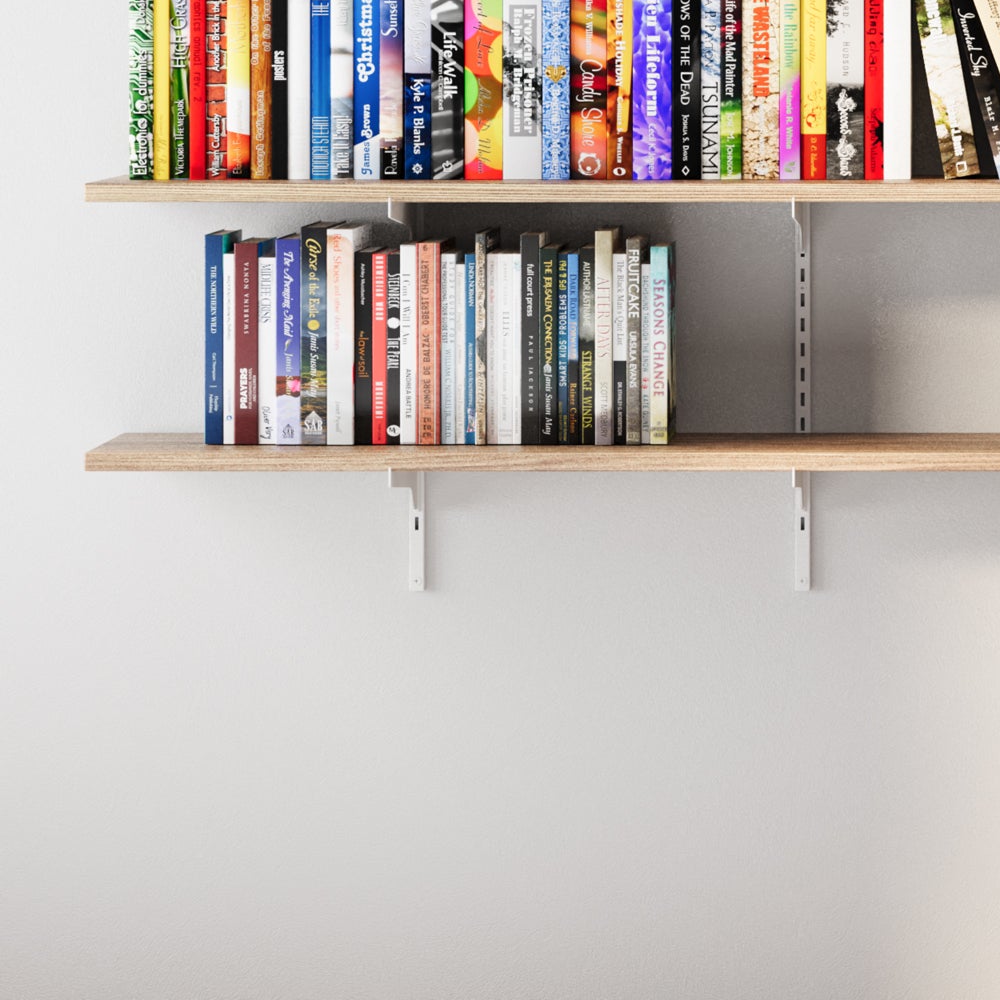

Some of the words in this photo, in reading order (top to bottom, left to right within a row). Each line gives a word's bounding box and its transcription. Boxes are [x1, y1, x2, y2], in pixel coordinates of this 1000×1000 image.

[312, 2, 329, 17] THE
[381, 0, 398, 38] Sunset
[704, 11, 716, 21] P.
[725, 13, 736, 25] of
[783, 3, 797, 21] the
[443, 32, 457, 58] Life
[523, 7, 536, 61] Frozen
[680, 25, 691, 41] OF
[704, 25, 716, 68] PAYTON
[725, 25, 736, 39] the
[783, 24, 797, 69] Rainbow
[957, 8, 979, 51] Inverted
[969, 53, 988, 77] Sky
[171, 35, 187, 68] HIGH
[193, 37, 201, 66] annual
[272, 50, 286, 80] posters
[615, 40, 625, 87] HOLIDAY
[680, 45, 691, 65] THE
[725, 41, 736, 62] Mad
[753, 7, 769, 97] WASTELAND
[133, 49, 148, 96] dummies
[193, 72, 201, 90] rev.
[443, 61, 457, 100] Walk
[646, 35, 660, 117] Lifeform
[725, 64, 736, 97] Painter
[412, 79, 424, 102] Kyle
[523, 67, 536, 134] Prisoner
[679, 71, 693, 105] DEAD
[134, 99, 148, 114] for
[413, 105, 424, 115] P.
[312, 116, 329, 144] STEAM
[413, 117, 424, 154] Blanks
[681, 114, 690, 135] JOSHUA
[702, 81, 718, 174] TSUNAMI
[133, 118, 148, 175] Electronics
[312, 146, 329, 175] MONICA
[681, 145, 690, 161] DAVIS
[305, 238, 322, 271] Curse
[544, 260, 552, 274] THE
[309, 272, 320, 281] of
[309, 283, 321, 295] the
[526, 277, 534, 296] court
[569, 274, 577, 295] DARK
[628, 249, 640, 318] FRUITCAKE
[309, 298, 320, 318] Exile
[525, 297, 533, 317] press
[543, 276, 552, 312] JERUSALEM
[569, 297, 577, 319] ROAD
[597, 276, 610, 318] AFTER
[653, 279, 666, 335] SEASONS
[308, 331, 319, 351] Janis
[543, 314, 552, 364] CONNECTION
[597, 324, 610, 358] DAYS
[629, 331, 637, 361] URSULA
[310, 353, 319, 376] Susan
[582, 350, 593, 391] STRANGE
[629, 363, 637, 388] EVANS
[653, 341, 666, 397] CHANGE
[239, 367, 247, 409] PRAYERS
[307, 378, 319, 397] May
[544, 372, 552, 391] Janis
[544, 393, 552, 415] Susan
[582, 396, 593, 428] WINDS
[543, 417, 553, 435] May
